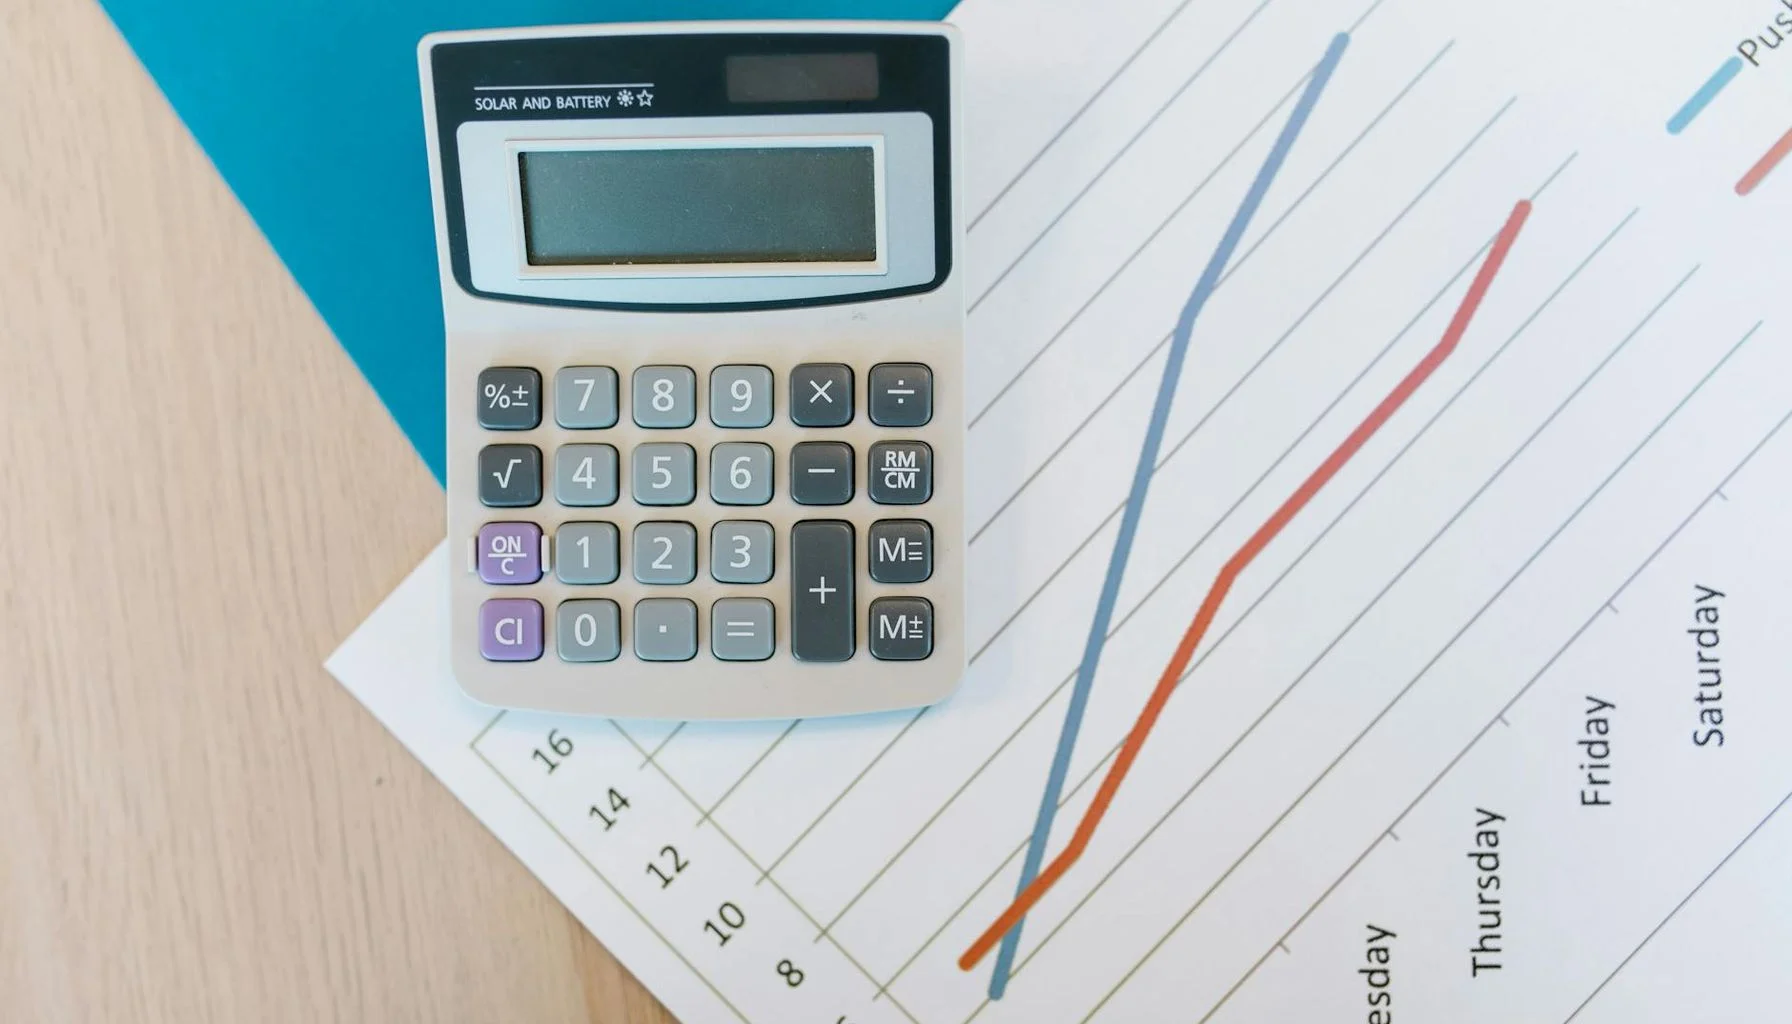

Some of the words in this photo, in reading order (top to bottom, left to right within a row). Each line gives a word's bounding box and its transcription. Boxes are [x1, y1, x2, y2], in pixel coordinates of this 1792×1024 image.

[475, 97, 517, 111] SOLAR
[522, 97, 551, 110] AND
[556, 95, 612, 109] BATTERY
[573, 379, 596, 412] 7
[652, 379, 674, 412] 8
[730, 380, 753, 412] 9
[572, 457, 596, 489] 4
[652, 456, 672, 489] 5
[730, 456, 752, 489] 6
[885, 451, 916, 468] RM
[884, 472, 916, 489] CM
[491, 536, 522, 554] ON
[576, 536, 589, 568] 1
[652, 537, 673, 569] 2
[730, 535, 751, 568] 3
[501, 557, 515, 575] C
[574, 613, 597, 646] 0
[1687, 584, 1726, 747] Saturday
[531, 729, 574, 775] 16
[1578, 696, 1616, 806] Friday
[589, 787, 631, 831] 14
[646, 845, 690, 889] 12
[1467, 808, 1506, 977] Thursday
[704, 901, 746, 947] 10
[776, 959, 805, 988] 8
